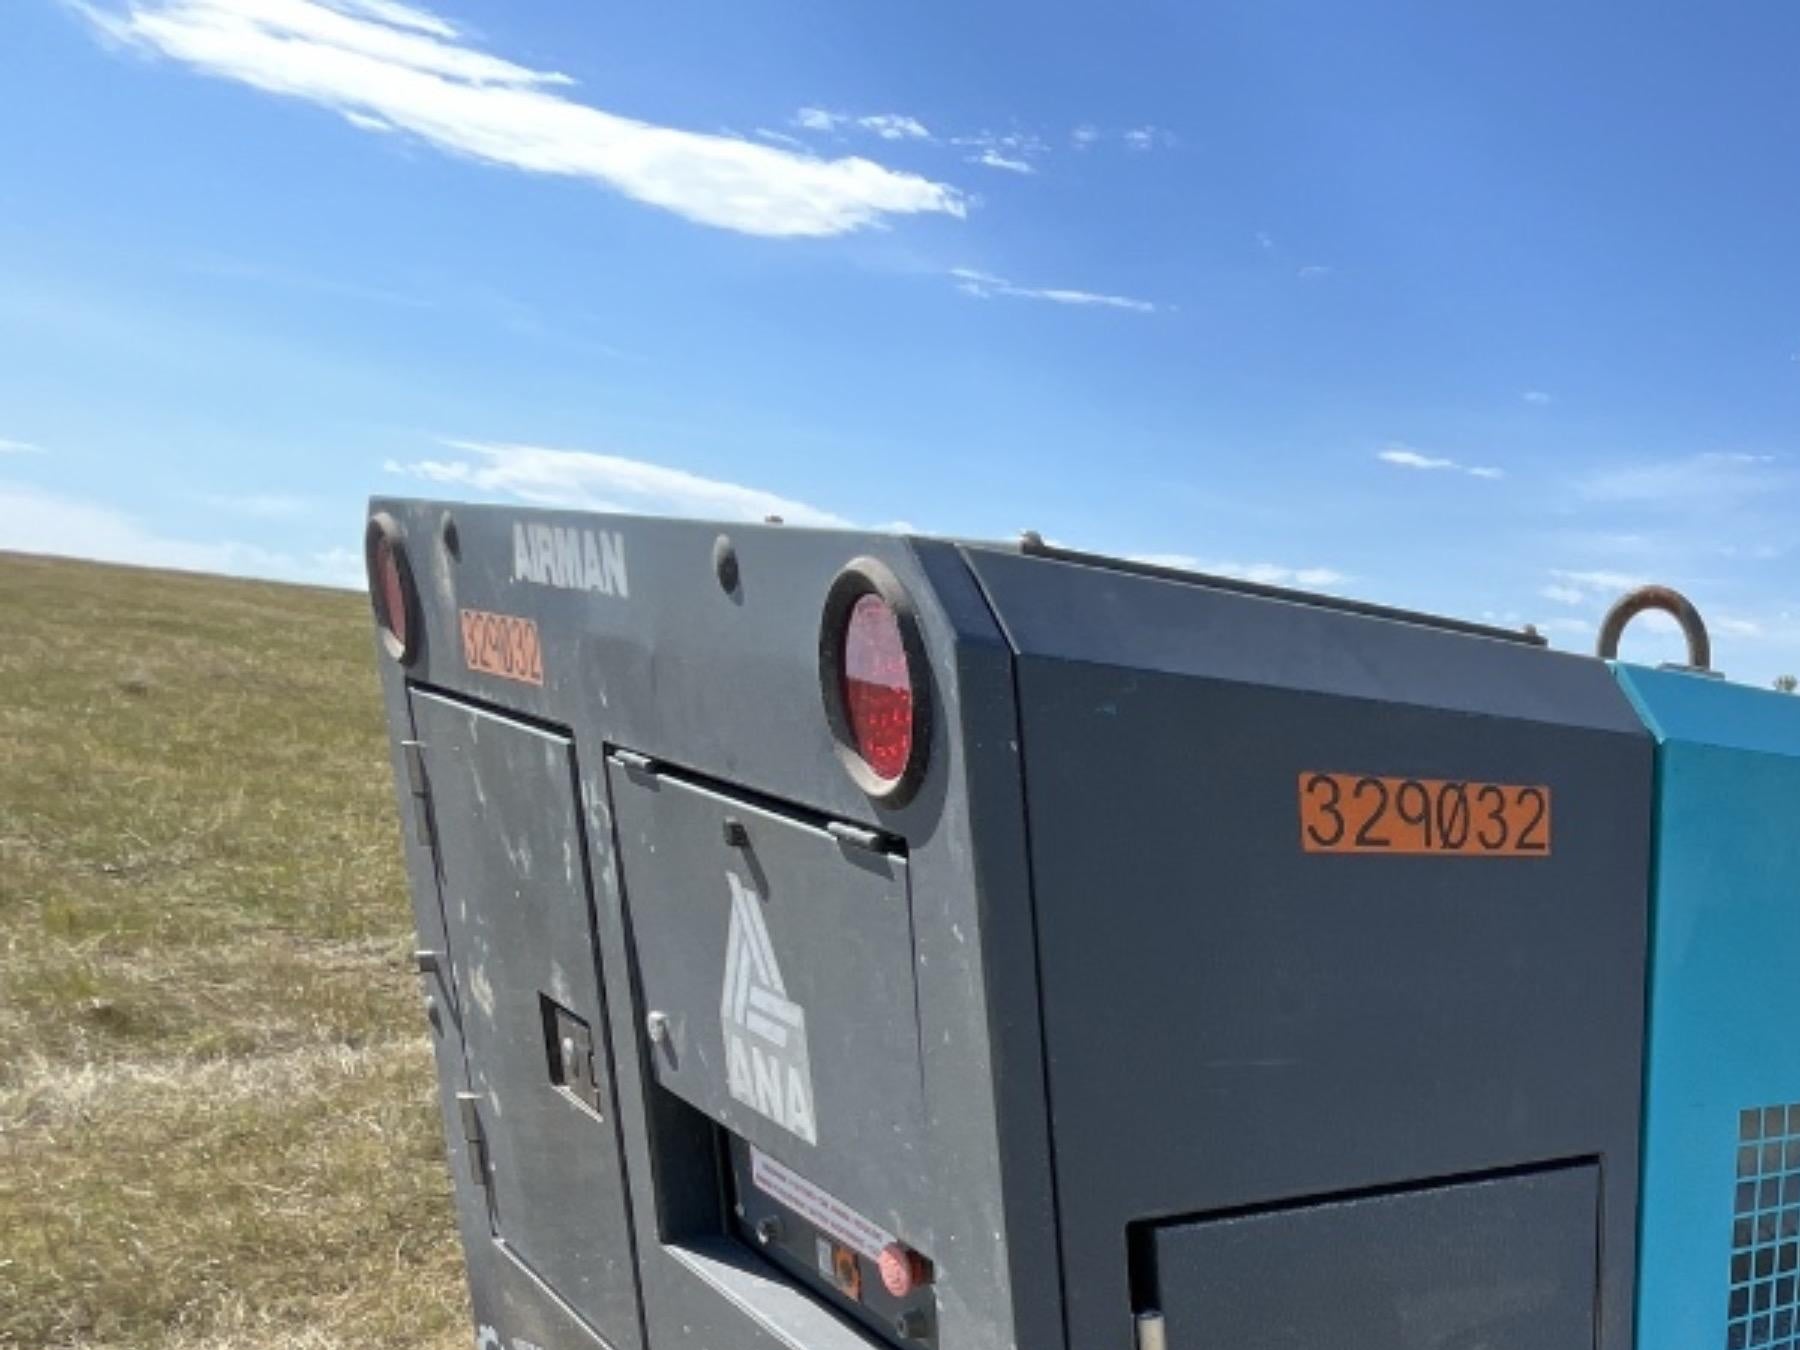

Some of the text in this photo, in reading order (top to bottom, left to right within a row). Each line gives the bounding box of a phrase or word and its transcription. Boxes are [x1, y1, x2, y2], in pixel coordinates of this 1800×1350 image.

[512, 523, 629, 598] AIRMAN
[1306, 774, 1546, 850] 329032
[725, 1034, 817, 1147] ANA
